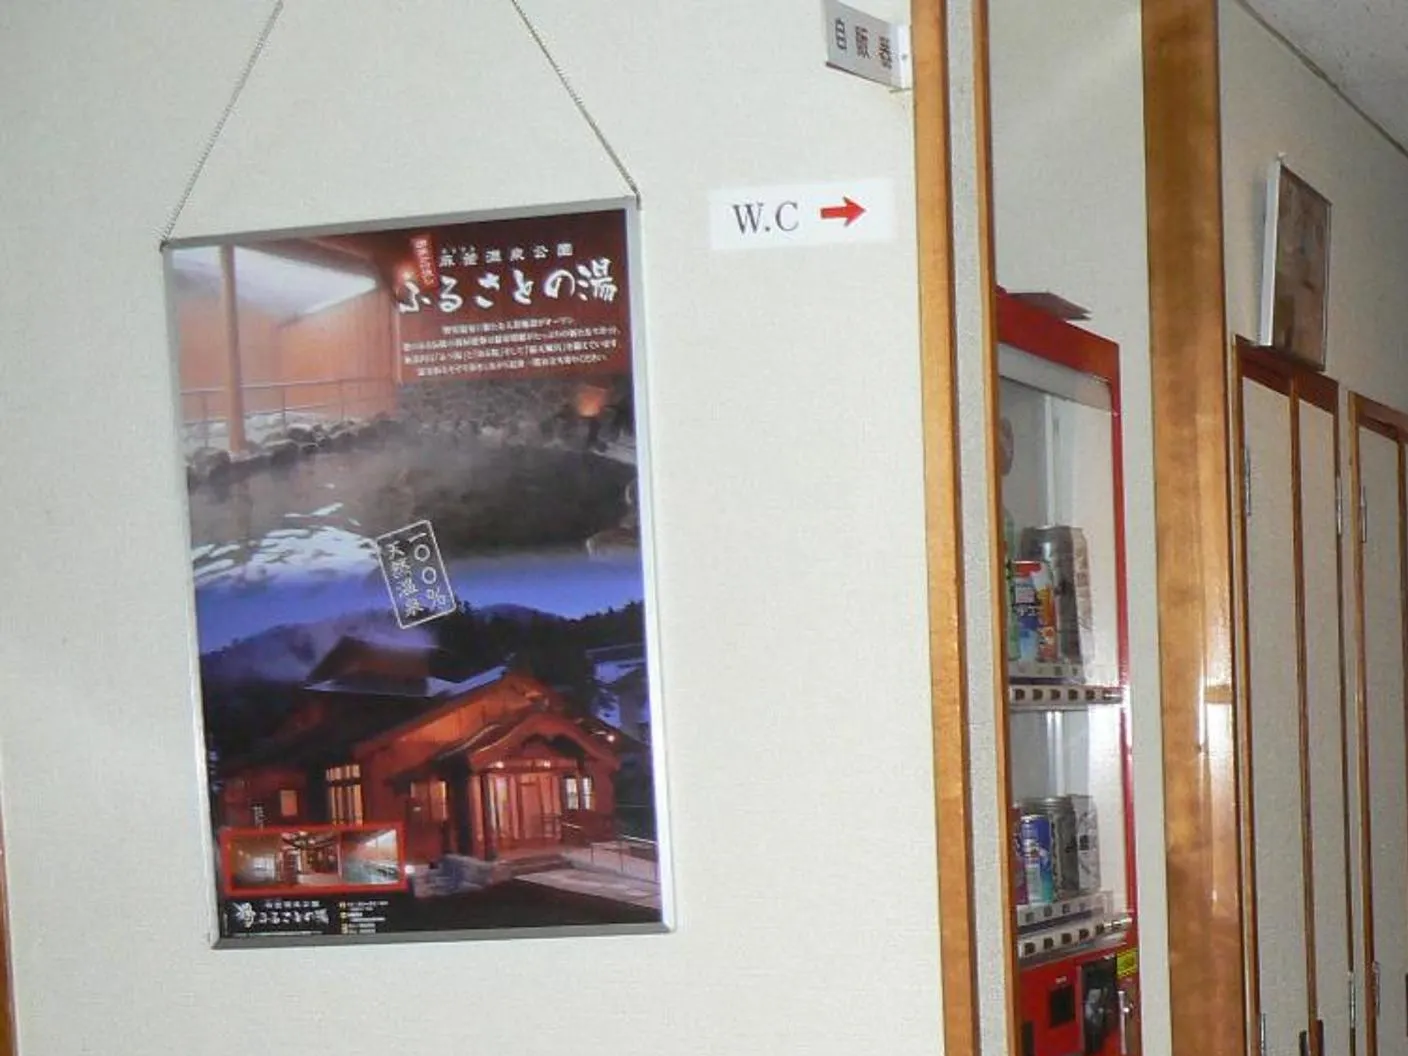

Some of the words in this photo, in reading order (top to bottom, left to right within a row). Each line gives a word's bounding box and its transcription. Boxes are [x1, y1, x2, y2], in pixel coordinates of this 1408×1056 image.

[732, 201, 799, 234] W.C
[398, 257, 618, 313] ふるさとの湯
